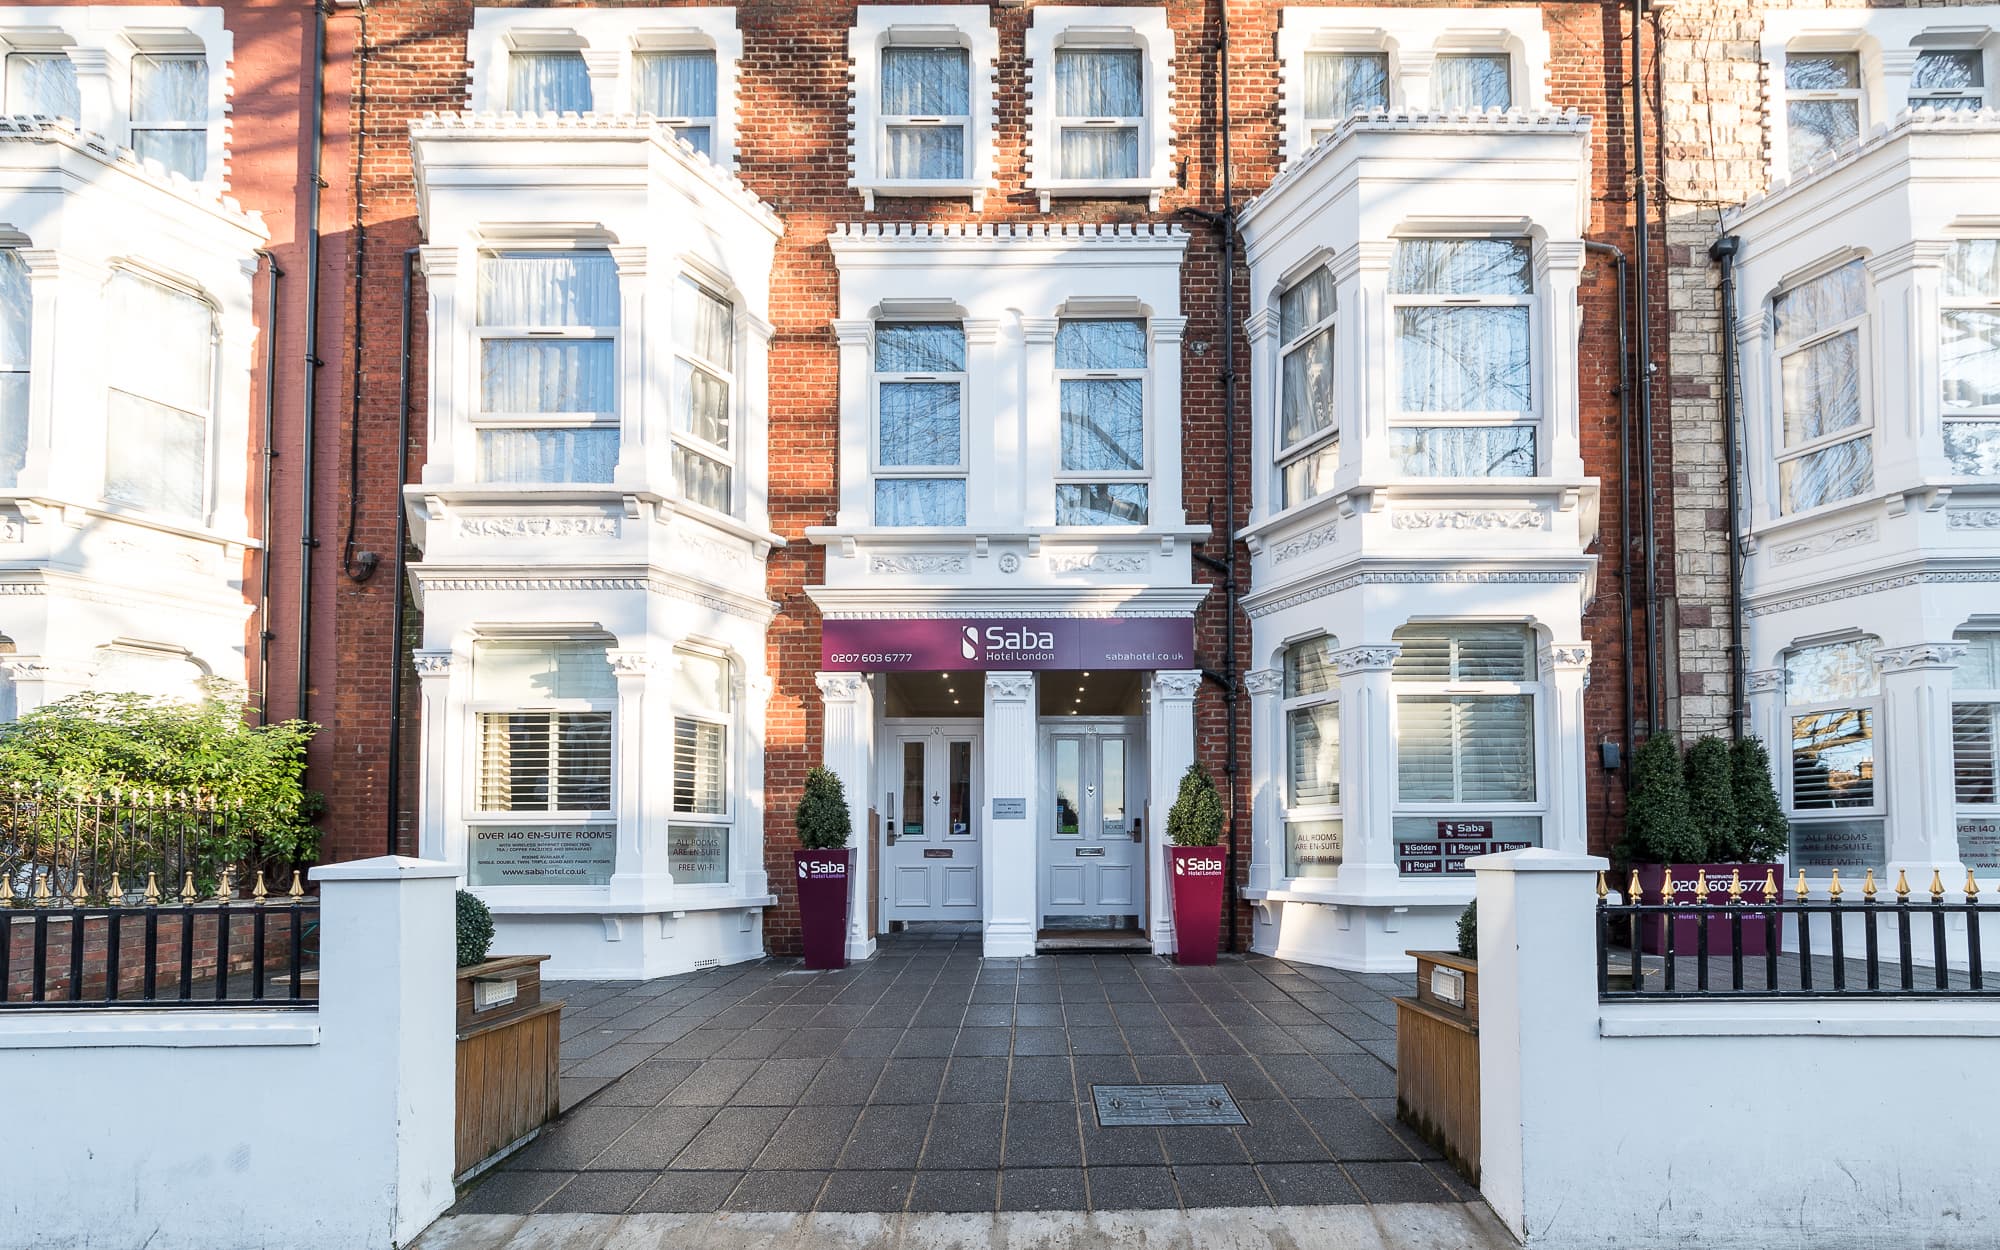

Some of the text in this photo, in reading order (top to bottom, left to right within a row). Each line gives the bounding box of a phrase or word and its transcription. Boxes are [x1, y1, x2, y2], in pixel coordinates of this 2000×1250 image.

[986, 626, 1054, 650] Saba
[831, 653, 912, 662] 0207 603 6777
[986, 652, 1054, 661] Hotel London
[1105, 652, 1184, 661] sabahotel.co.uk
[1457, 824, 1485, 832] Saba
[810, 861, 845, 873] Saba
[1188, 857, 1222, 870] Saba
[1672, 880, 1706, 892] 020
